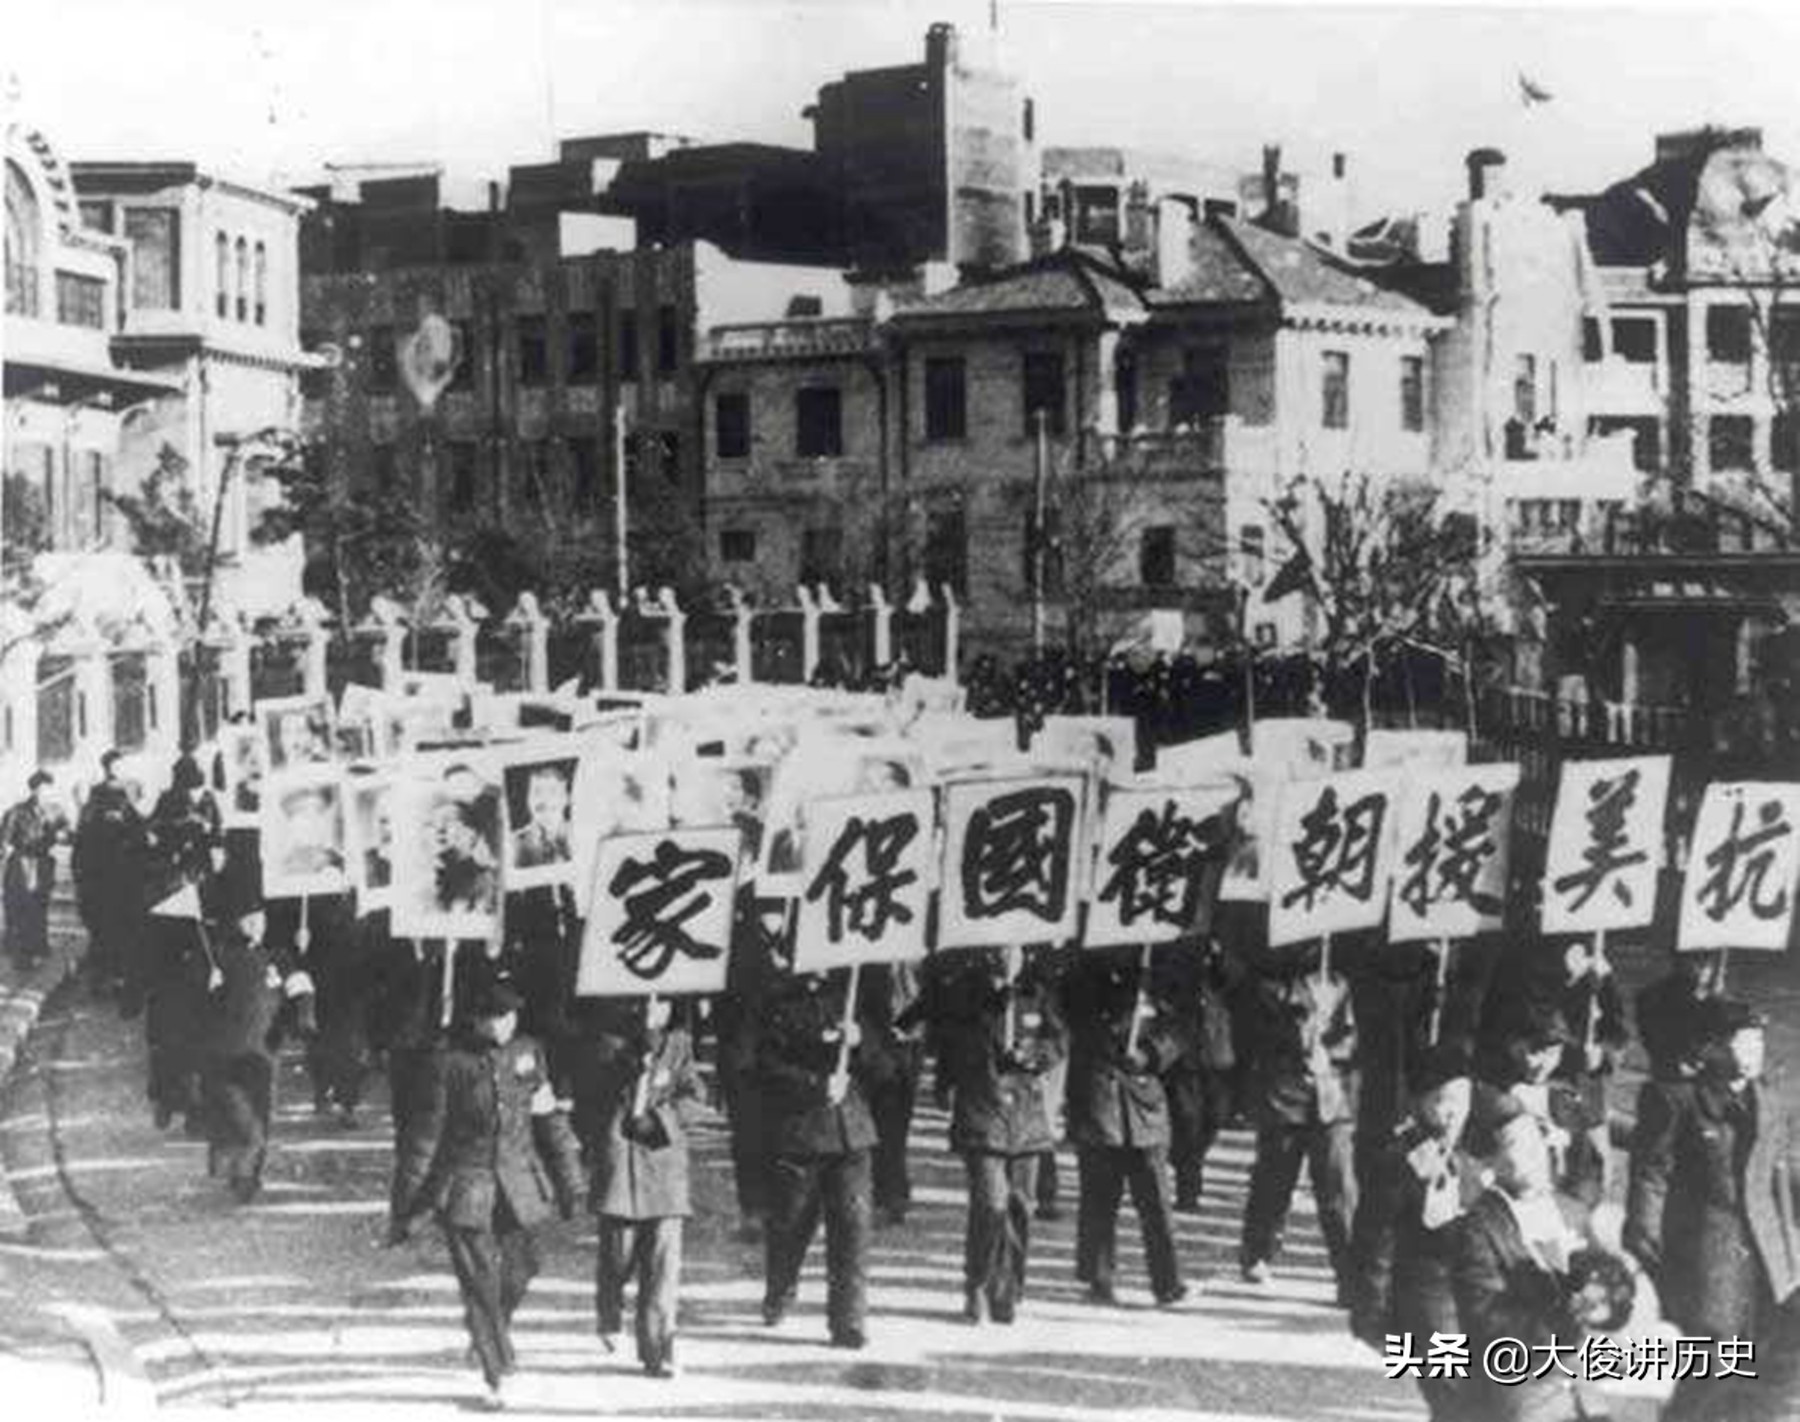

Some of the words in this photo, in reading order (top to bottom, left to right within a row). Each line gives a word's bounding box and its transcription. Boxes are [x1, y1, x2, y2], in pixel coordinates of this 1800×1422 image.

[806, 811, 920, 944] 保
[960, 787, 1076, 922] 國
[1282, 787, 1388, 912] 朝
[1402, 784, 1501, 918] 援
[1554, 769, 1651, 913] 美
[1696, 800, 1793, 922] 抗
[608, 839, 733, 980] 家
